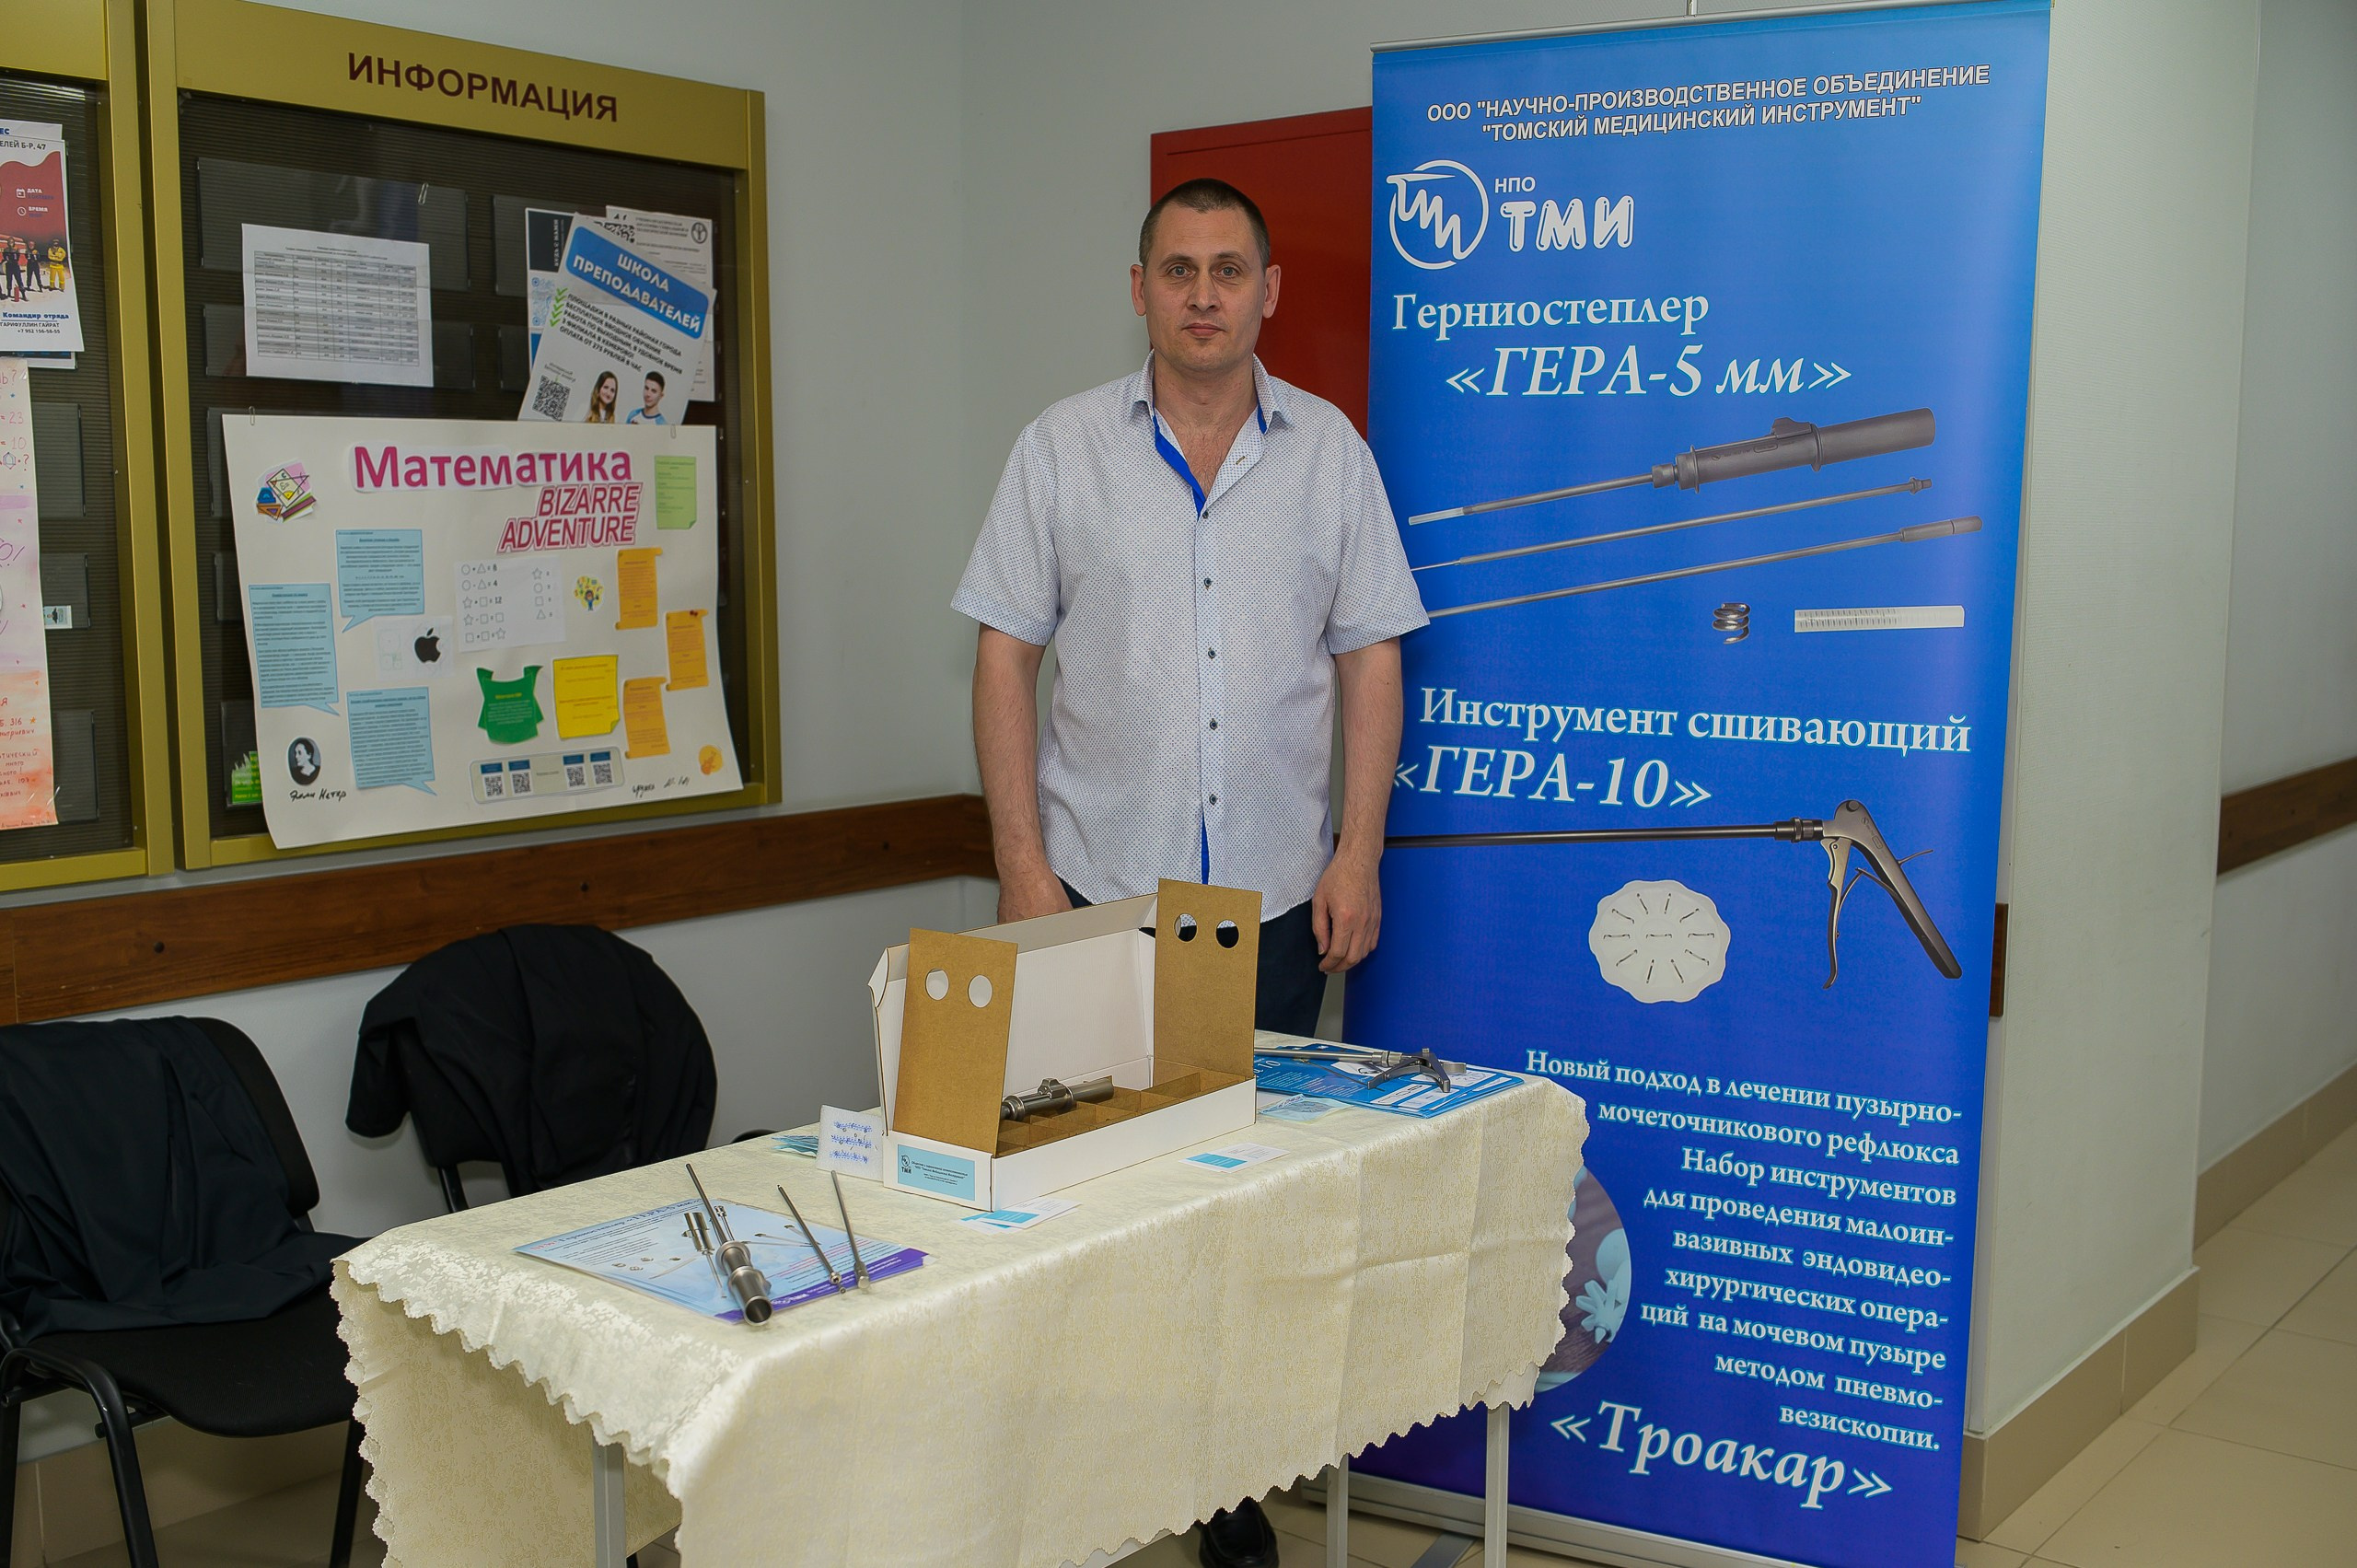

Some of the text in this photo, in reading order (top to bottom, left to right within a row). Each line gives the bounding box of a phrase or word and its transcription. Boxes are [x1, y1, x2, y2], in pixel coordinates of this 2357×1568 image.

[348, 52, 617, 122] ИНФОРМАЦИЯ
[1428, 64, 1990, 122] ООО "НАУЧНО-ПРОИЗВОДСТВЕННОЕ ОБЪЕДИНЕНИЕ
[1481, 95, 1922, 141] "ТОМСКИЙ МЕДИЦИНСКИЙ ИНСТРУМЕНТ"
[1494, 176, 1536, 193] НПО
[1500, 195, 1634, 252] ТМИ
[573, 255, 701, 332] ПРЕПОДАВАТЕЛЕЙ
[617, 253, 669, 292] ШКОЛА
[559, 325, 583, 342] ОПЛАТА
[563, 308, 586, 325] РАБОТА
[1392, 293, 1709, 342] Герниостеплер
[658, 341, 681, 357] ГОРОДА
[1446, 343, 1852, 397] «ГЕРА-5 мм»
[354, 445, 633, 488] Математика
[536, 483, 642, 518] BIZARRE
[498, 513, 638, 552] ADVENTURE
[1419, 686, 1971, 757] Инструмент сшивающий
[1394, 745, 1712, 807] «ГЕРА-10»
[1526, 1049, 1962, 1127] Новый подход в лечении пузырно-
[1598, 1102, 1960, 1165] мочеточникового рефлюкса
[1682, 1147, 1957, 1206] Набор инструментов
[1643, 1189, 1955, 1249] для проведения малоин-
[1673, 1230, 1951, 1287] вазивных эндовидео-
[1665, 1268, 1949, 1333] хирургических опера-
[1641, 1302, 1947, 1375] ций на мочевом пузыре
[1714, 1353, 1945, 1410] методом пневмо-
[1550, 1400, 1893, 1509] «Троакар»
[1779, 1404, 1941, 1451] везископии.
